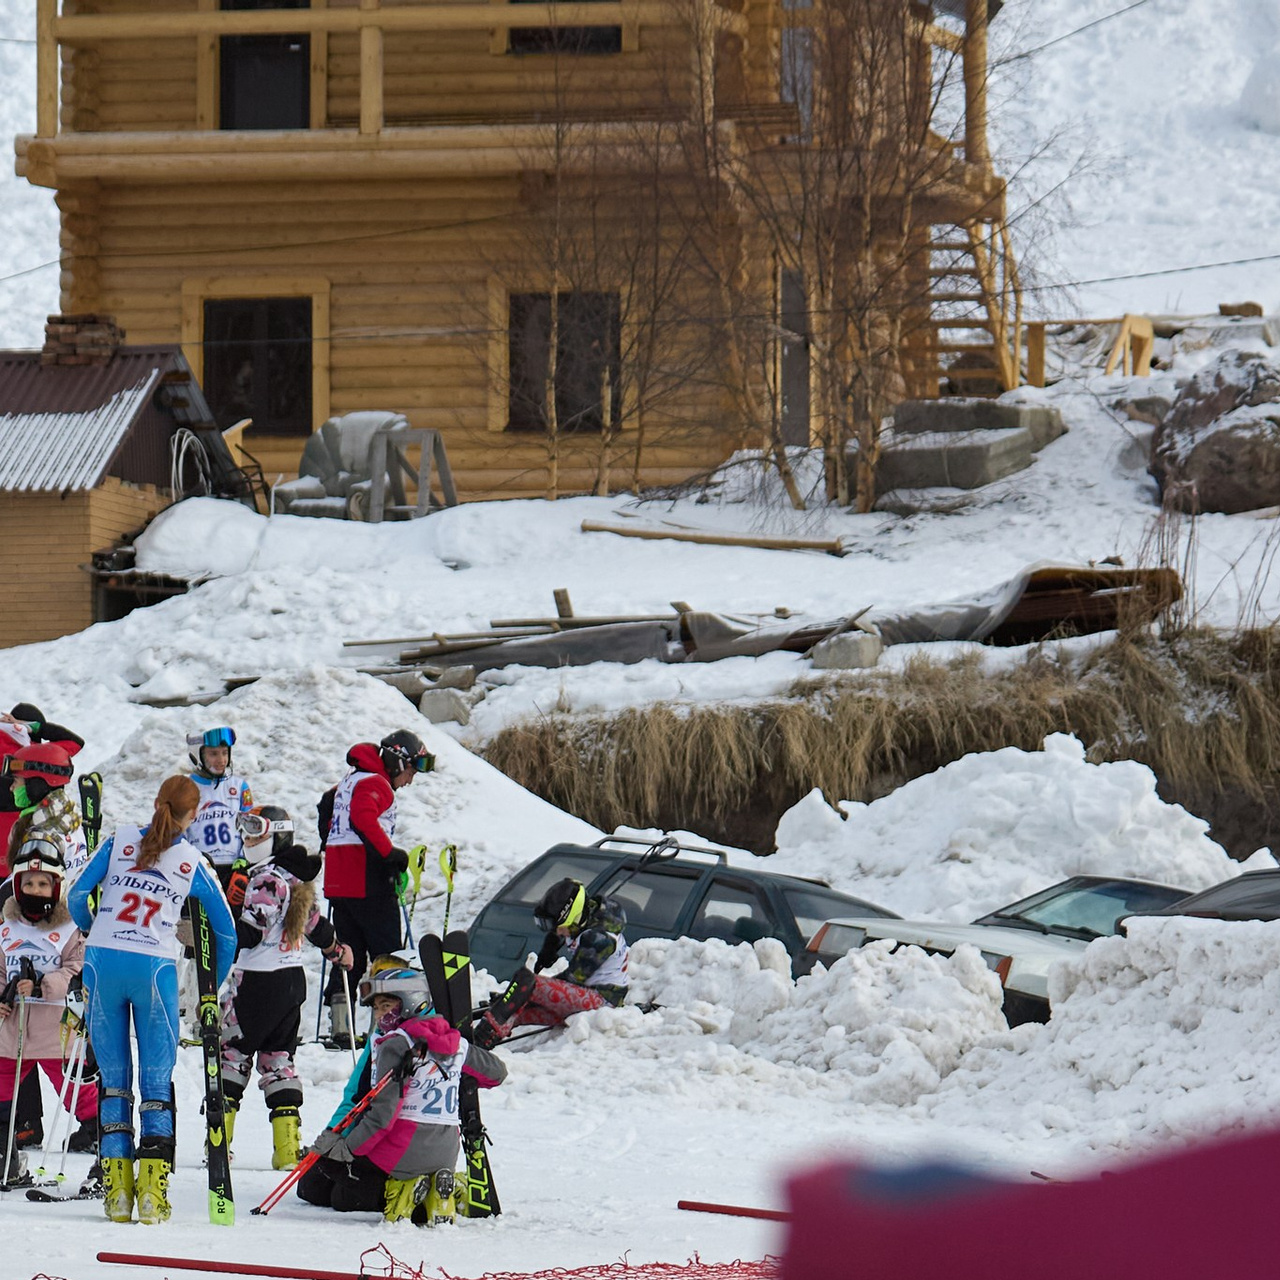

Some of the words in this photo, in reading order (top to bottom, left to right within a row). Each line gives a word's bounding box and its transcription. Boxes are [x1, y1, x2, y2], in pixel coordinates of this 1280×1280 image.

[204, 822, 231, 846] 86
[110, 874, 183, 905] ЭЛЬБРУС
[116, 891, 163, 928] 27
